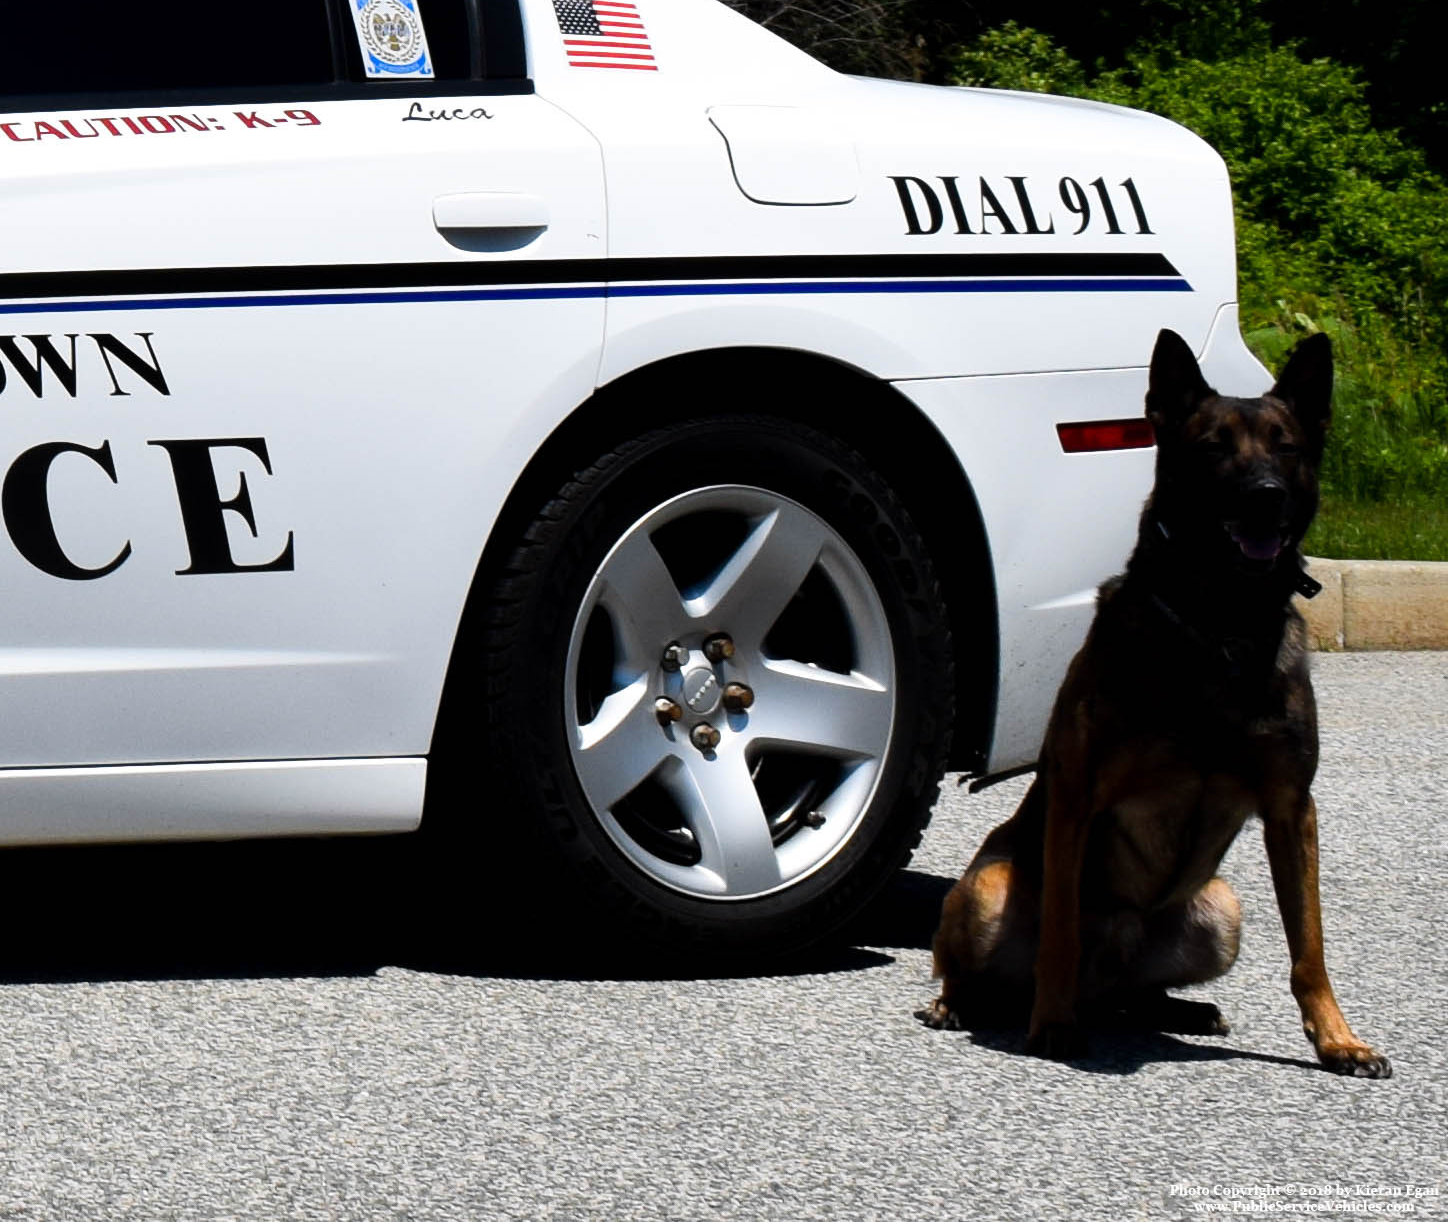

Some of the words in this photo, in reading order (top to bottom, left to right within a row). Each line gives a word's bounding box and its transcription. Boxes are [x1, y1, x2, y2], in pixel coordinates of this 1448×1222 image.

[0, 114, 225, 142] CAUTION:
[235, 109, 322, 129] K-9
[402, 101, 494, 123] Luca
[887, 175, 1055, 236] DIAL
[1059, 175, 1155, 236] 911
